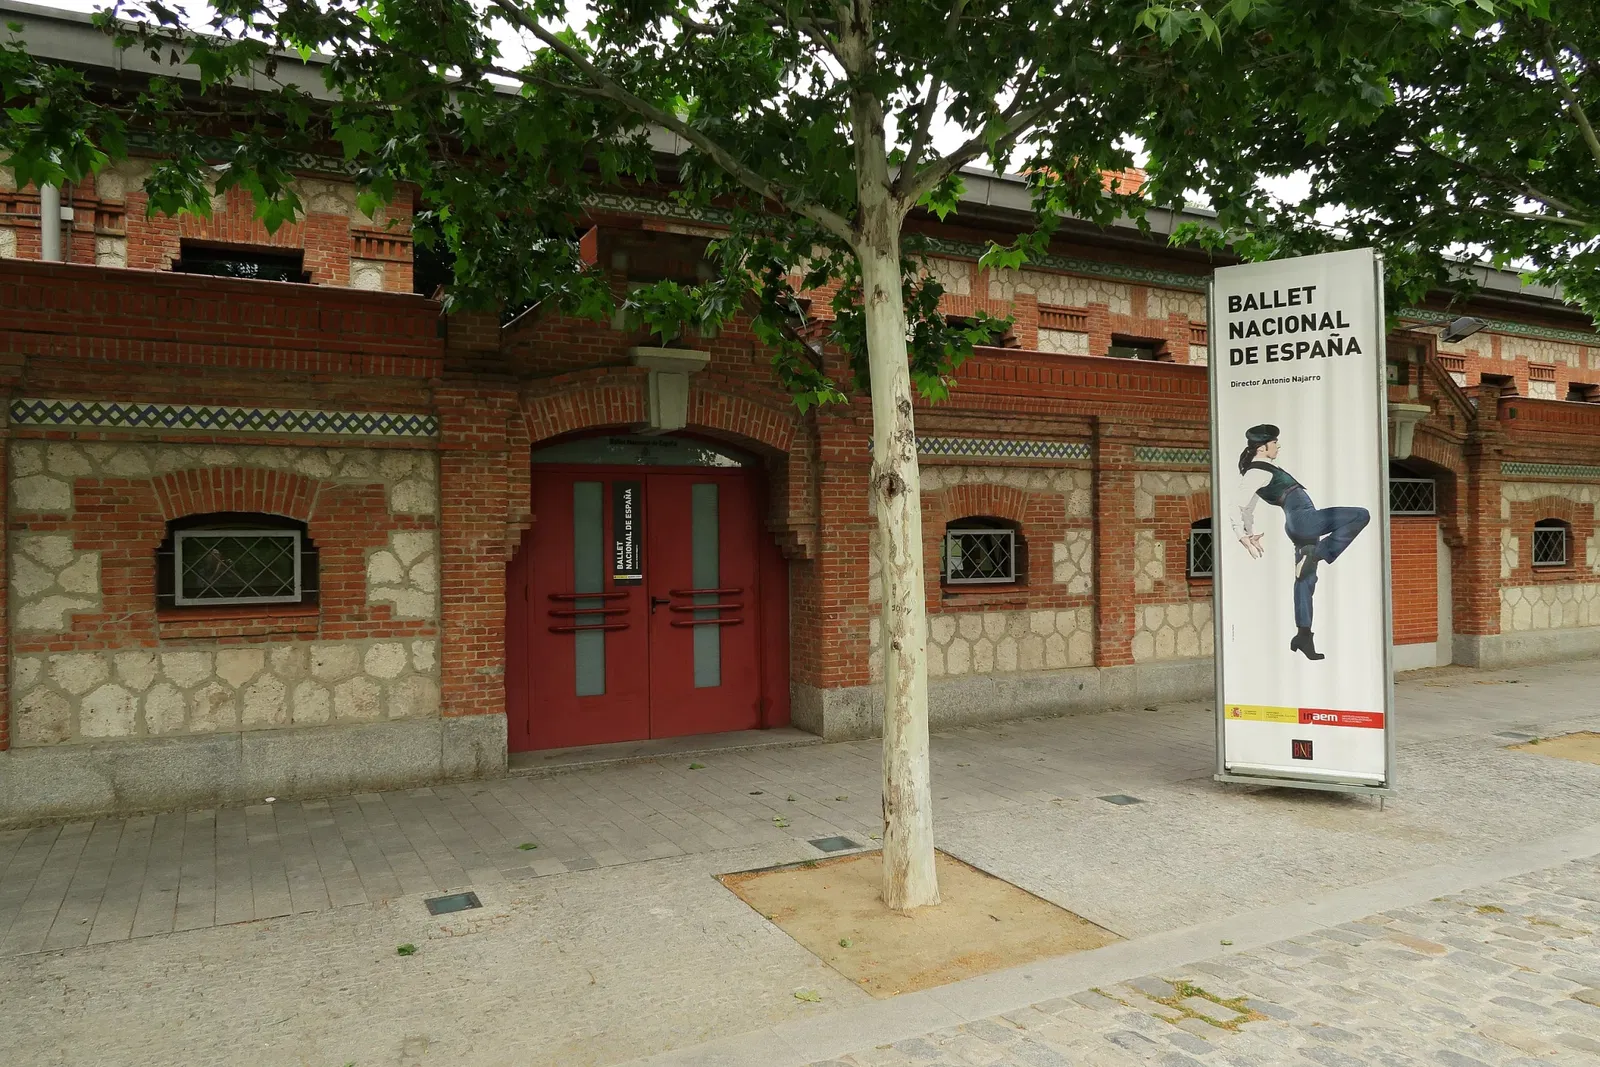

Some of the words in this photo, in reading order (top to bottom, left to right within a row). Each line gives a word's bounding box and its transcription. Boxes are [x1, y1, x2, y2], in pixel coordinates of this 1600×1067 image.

[1228, 286, 1316, 313] BALLET
[1229, 311, 1349, 340] NACIONAL
[1230, 346, 1258, 366] DE
[1266, 333, 1362, 363] ESPAÑA
[1230, 379, 1260, 388] Director
[1262, 376, 1290, 385] Antonio
[1292, 374, 1321, 383] Najarro
[623, 488, 632, 519] ESPAÑA
[625, 520, 632, 530] DE
[616, 541, 624, 570] BALLET
[625, 531, 633, 570] NACIONAL
[1303, 712, 1338, 722] inaem
[1294, 742, 1312, 758] BNE
